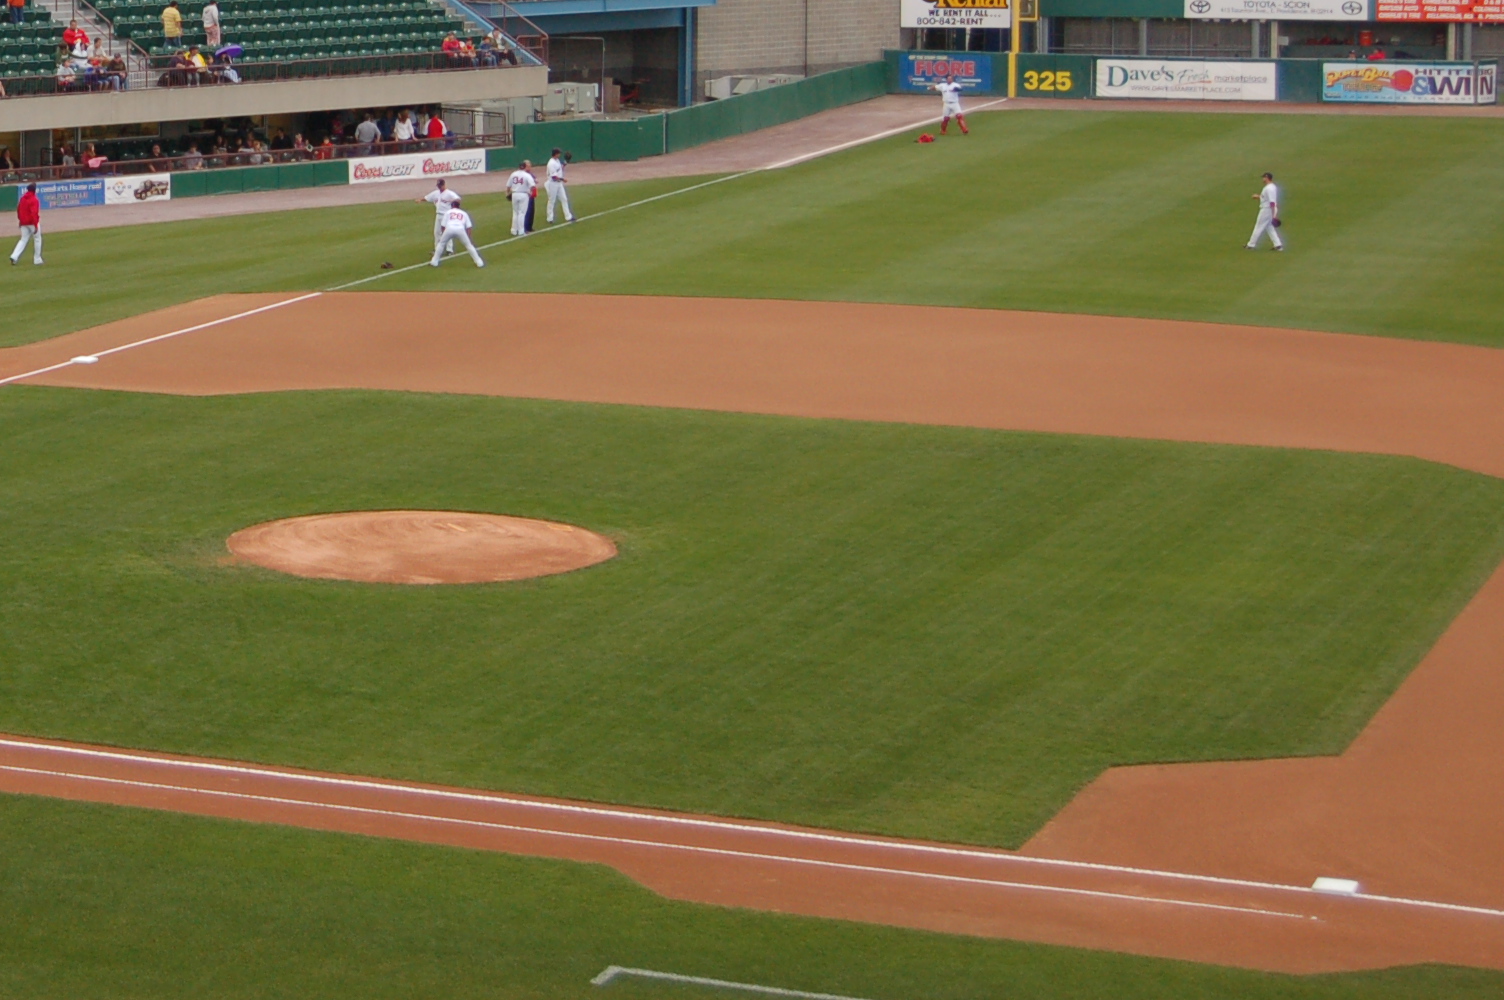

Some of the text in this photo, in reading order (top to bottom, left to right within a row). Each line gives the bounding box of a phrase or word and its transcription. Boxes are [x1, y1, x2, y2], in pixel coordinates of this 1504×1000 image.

[1243, 1, 1276, 9] TOYOTA
[1283, 1, 1310, 9] SCION
[914, 60, 976, 76] FIORE
[1106, 65, 1268, 87] Dave's Fresh marketplace
[1023, 70, 1073, 91] 325
[354, 163, 415, 180] Coors LIGHT
[423, 158, 482, 174] Coors LIGHT
